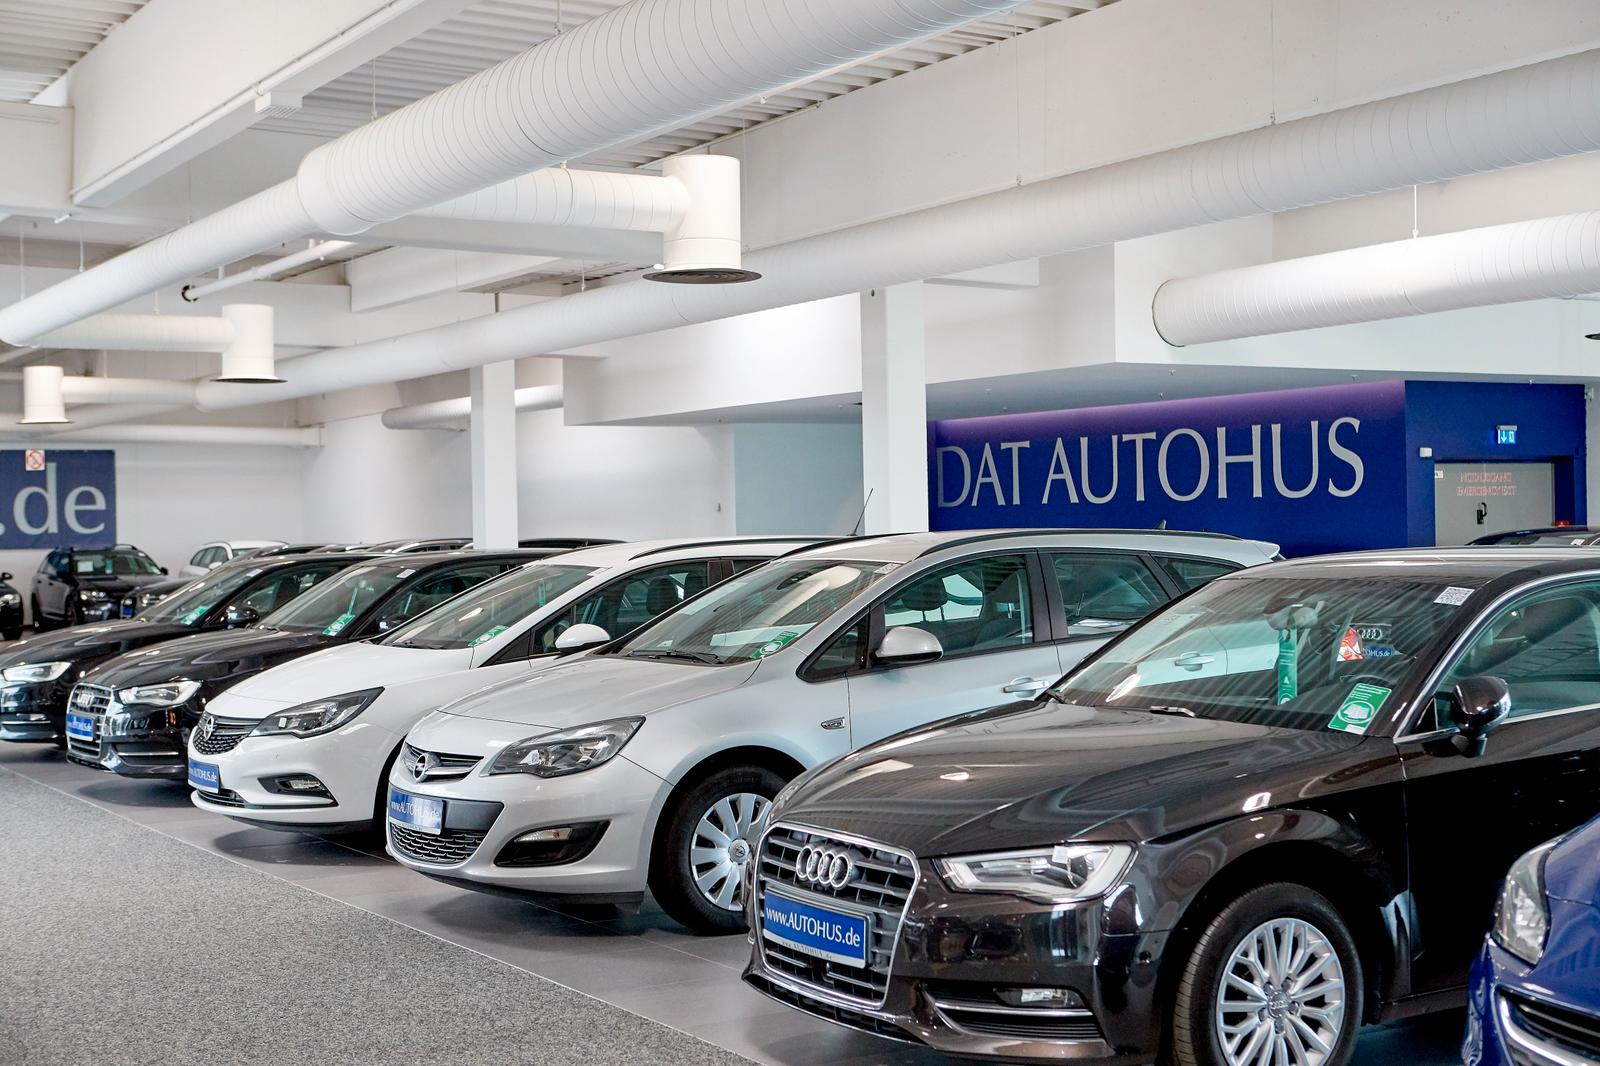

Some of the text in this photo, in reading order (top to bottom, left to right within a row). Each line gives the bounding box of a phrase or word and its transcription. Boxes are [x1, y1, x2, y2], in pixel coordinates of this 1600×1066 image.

[936, 416, 1364, 508] DAT AUTOHUS
[765, 907, 861, 948] www.AUTOHUS.de
